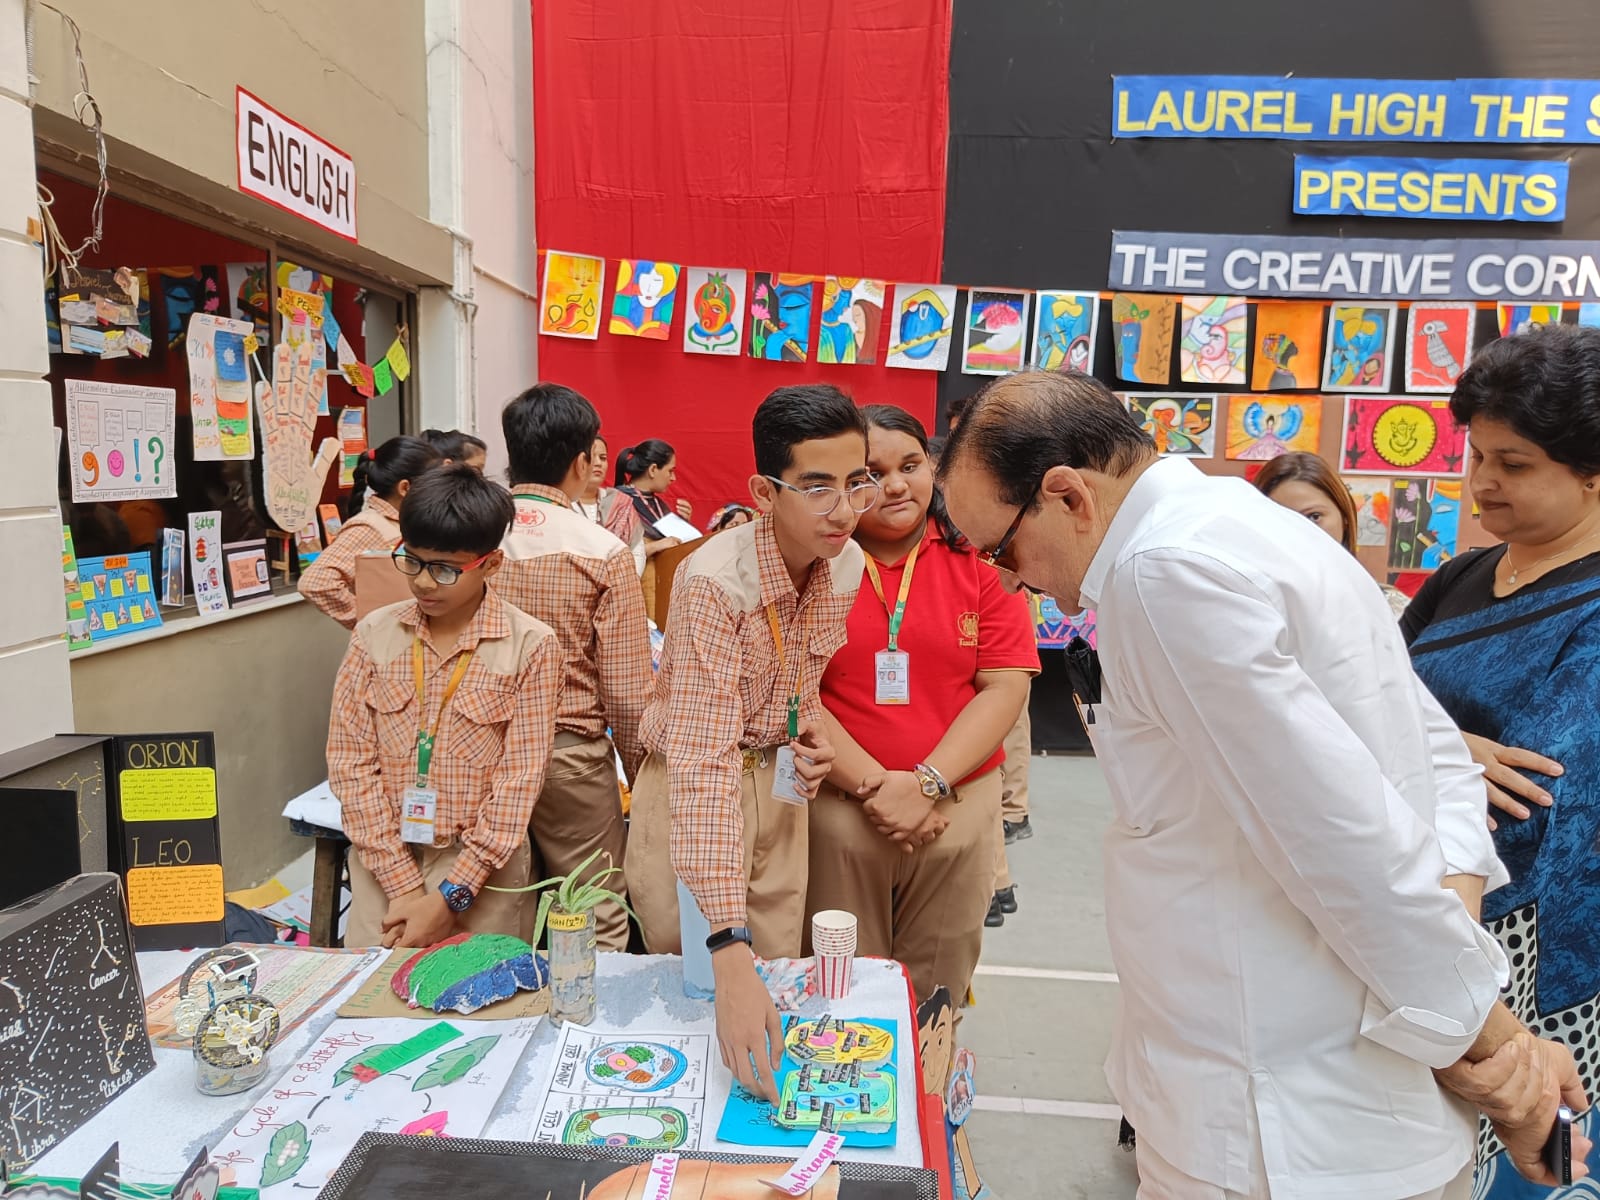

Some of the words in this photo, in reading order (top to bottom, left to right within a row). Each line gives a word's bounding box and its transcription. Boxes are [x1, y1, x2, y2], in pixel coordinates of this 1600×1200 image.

[1117, 90, 1313, 134] LAUREL
[1328, 93, 1447, 137] HIGH
[1470, 94, 1569, 138] THE
[247, 110, 351, 225] ENGLISH
[1298, 169, 1558, 216] PRESENTS
[1114, 244, 1208, 288] THE
[1223, 247, 1454, 295] CREATIVE
[128, 740, 199, 769] ORION
[132, 836, 192, 867] LEO
[89, 968, 120, 990] Cancer
[564, 1043, 579, 1060] CELL
[100, 1067, 134, 1098] Pisces
[233, 1104, 286, 1138] Cycle
[272, 1088, 318, 1100] of
[296, 1031, 375, 1073] Butterfly
[555, 1060, 574, 1087] ANIMAL
[542, 1110, 559, 1129] CELL
[20, 1133, 56, 1162] Libra
